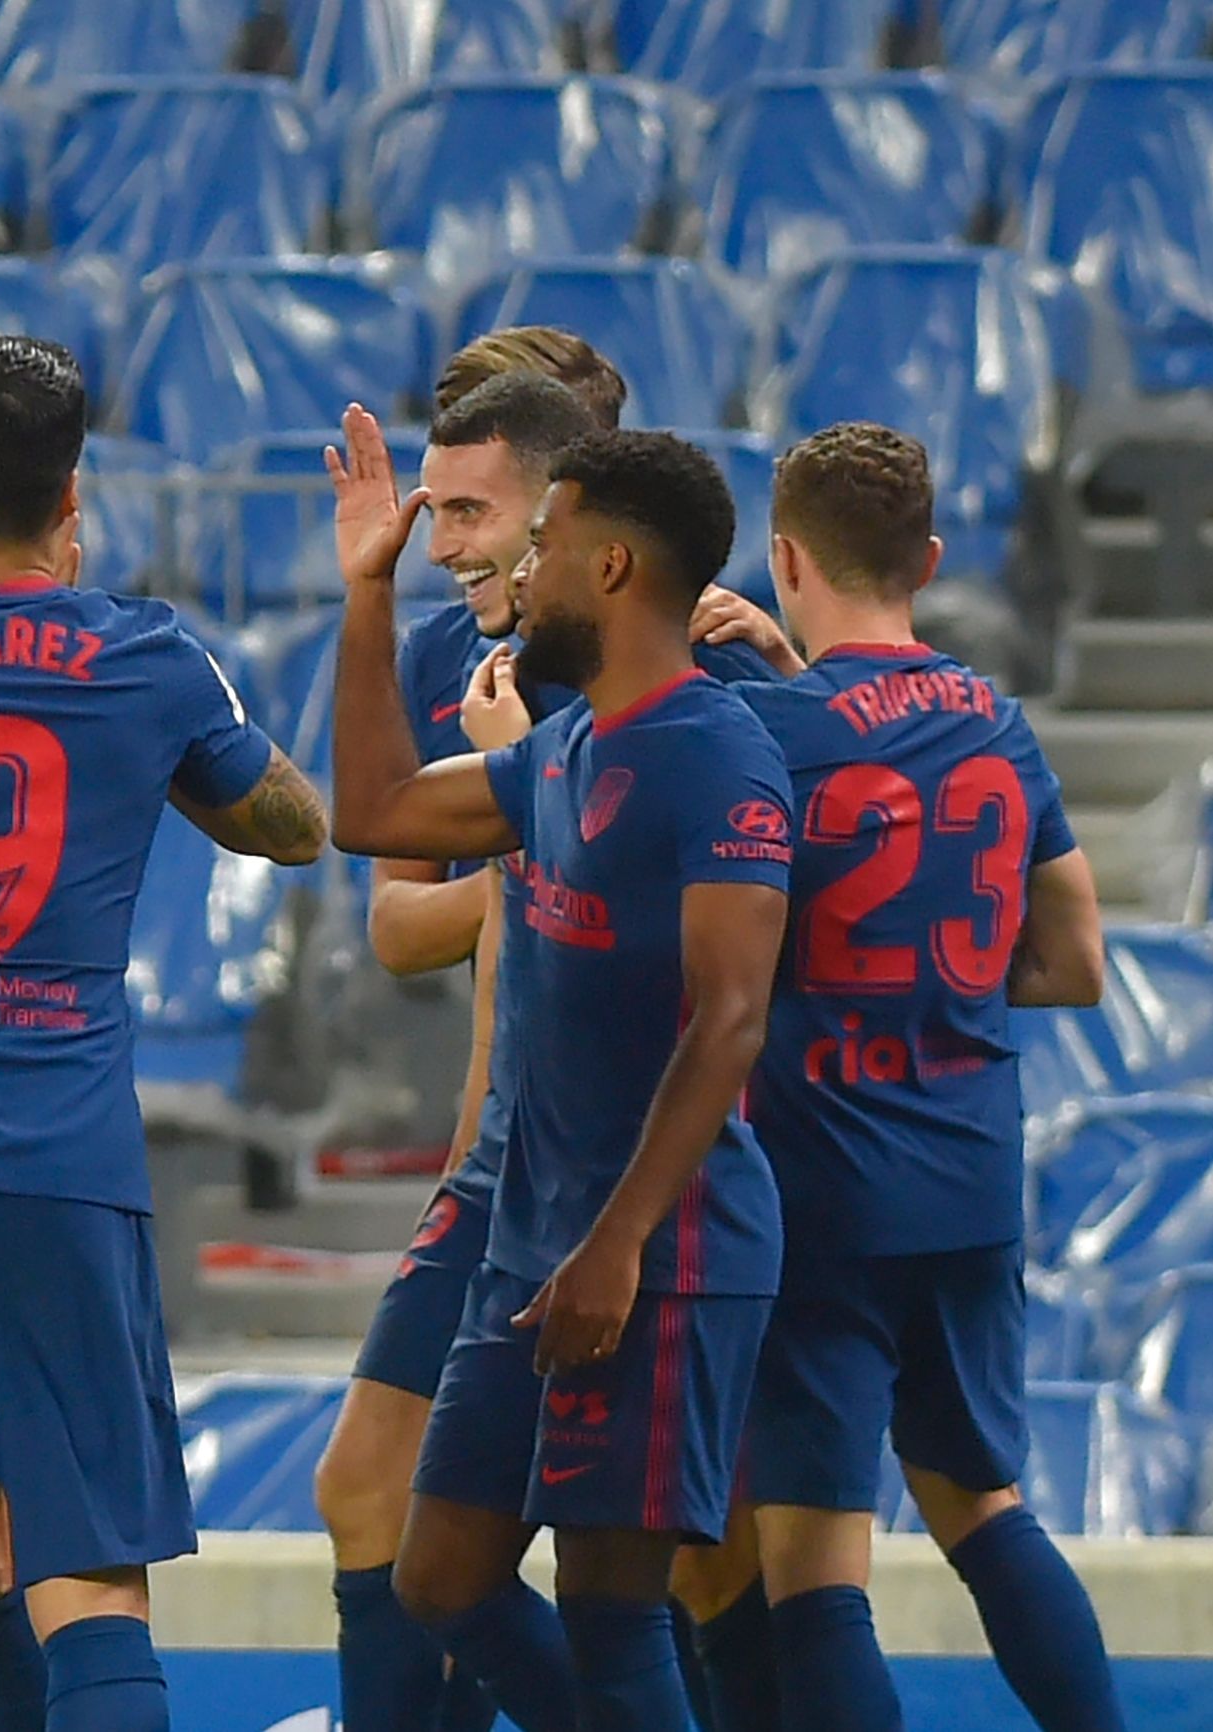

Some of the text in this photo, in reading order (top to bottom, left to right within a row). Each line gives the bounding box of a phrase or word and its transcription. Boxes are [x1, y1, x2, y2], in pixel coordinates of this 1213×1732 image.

[827, 671, 996, 736] TRIPPIER
[797, 754, 1028, 996] 23
[806, 1010, 908, 1086] ria
